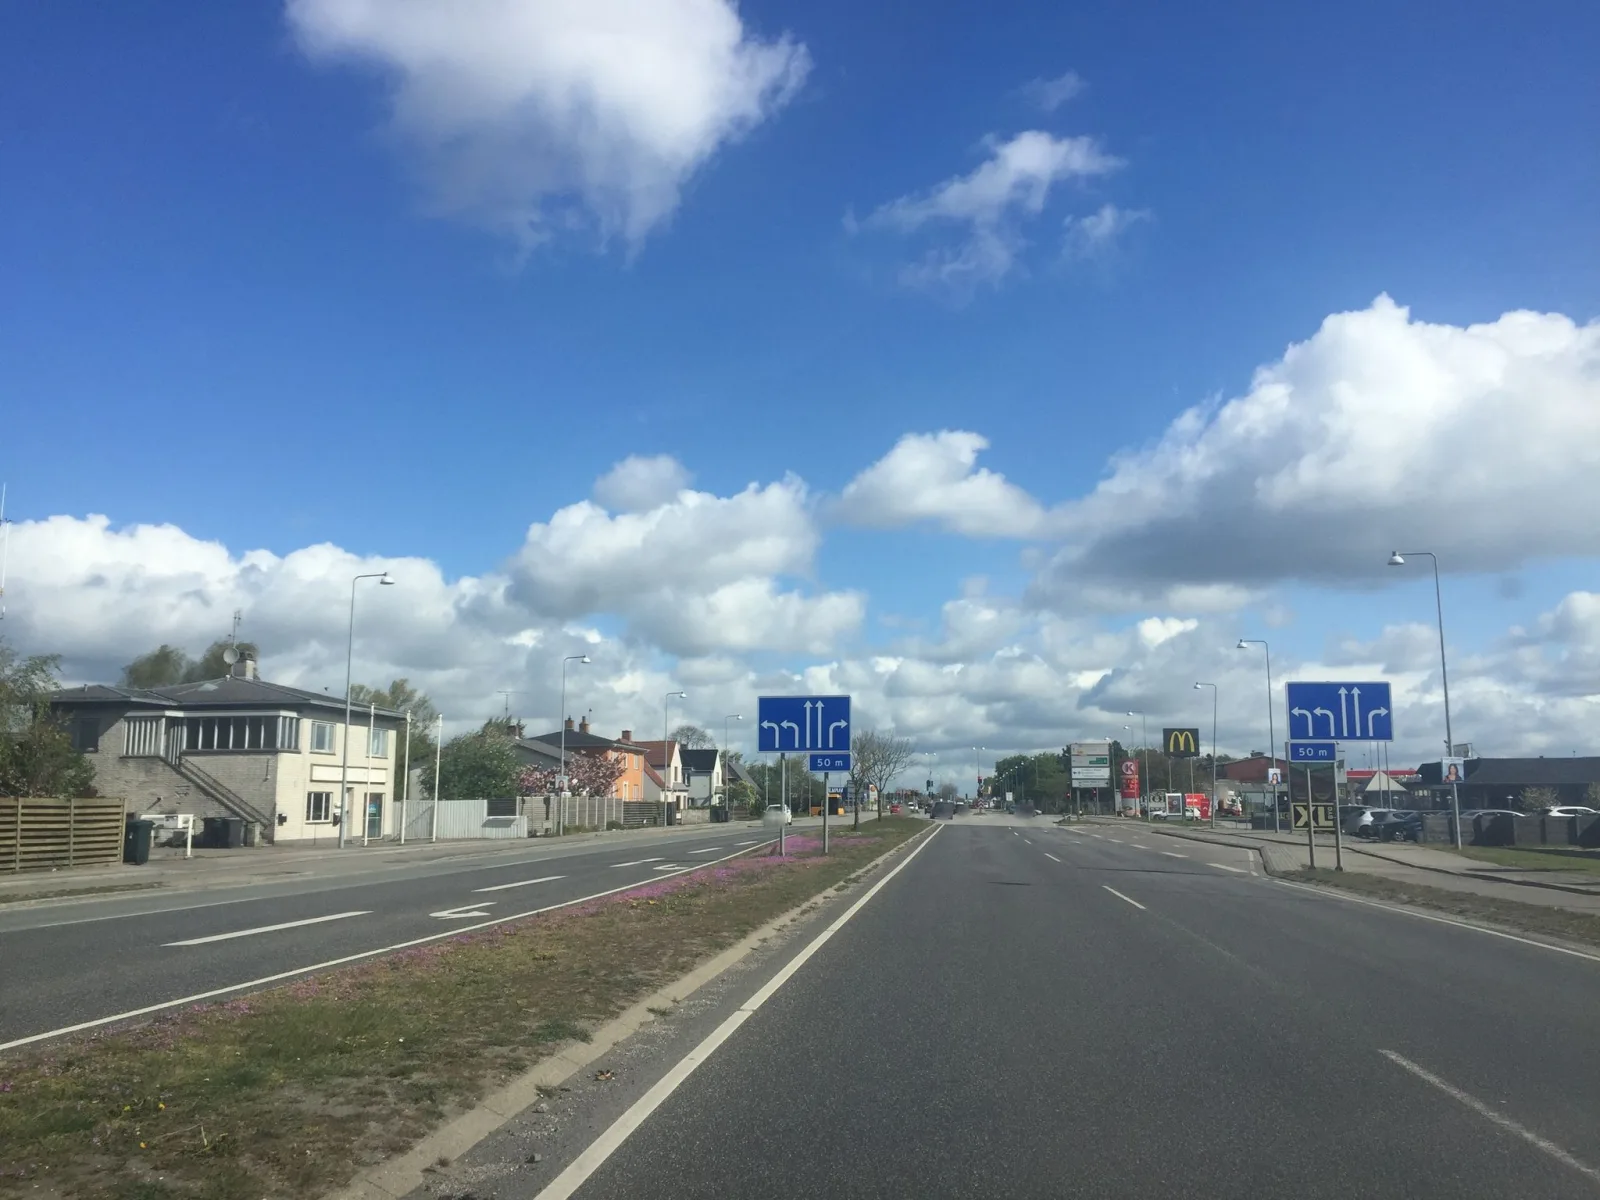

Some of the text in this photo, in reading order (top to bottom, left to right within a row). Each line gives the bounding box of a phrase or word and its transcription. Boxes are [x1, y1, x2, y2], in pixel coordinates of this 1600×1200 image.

[1299, 747, 1327, 757] 50 m
[817, 758, 831, 767] 50
[1125, 763, 1133, 773] K
[1295, 806, 1333, 827] XL
